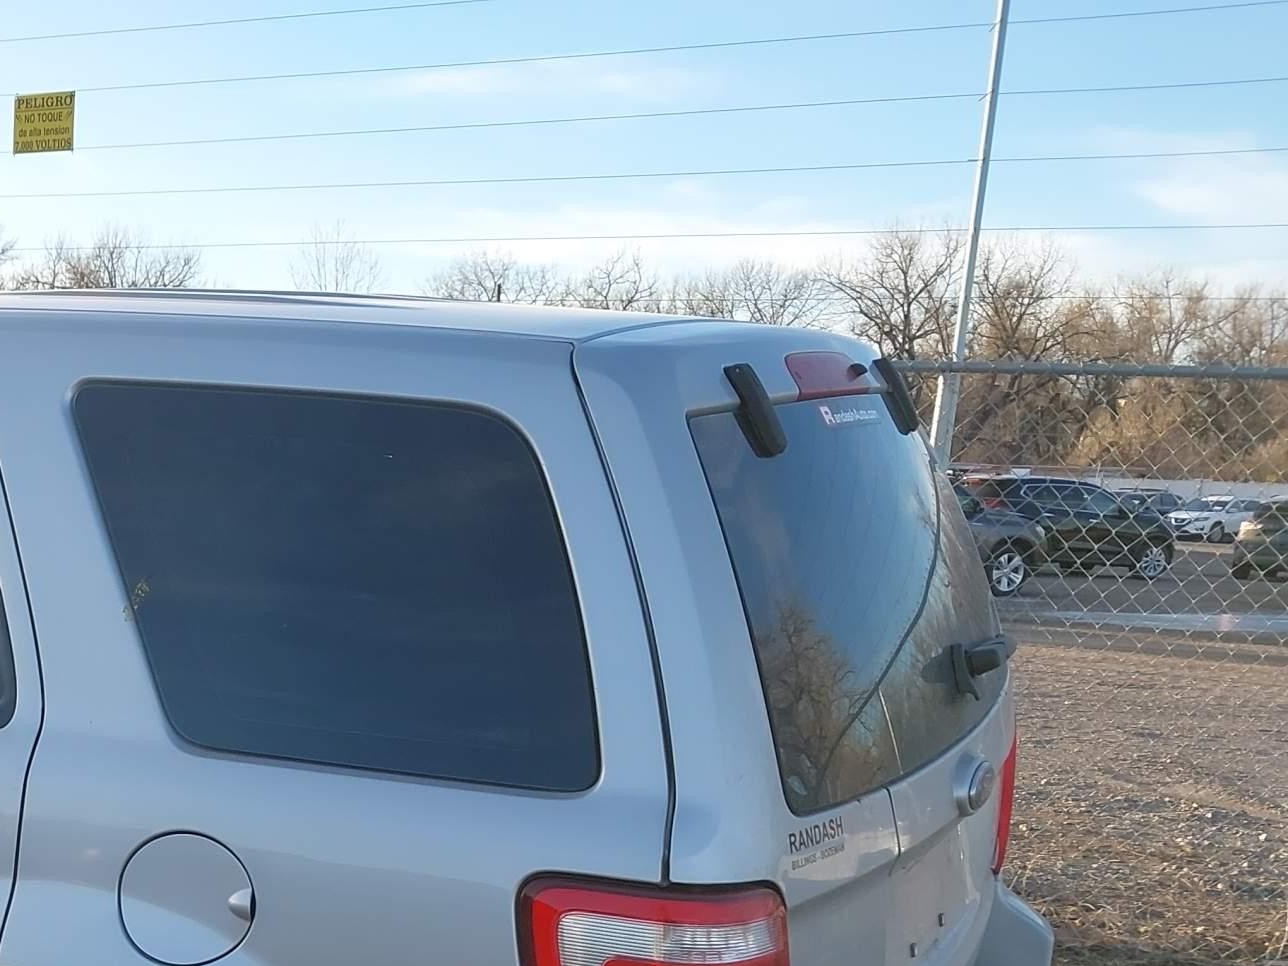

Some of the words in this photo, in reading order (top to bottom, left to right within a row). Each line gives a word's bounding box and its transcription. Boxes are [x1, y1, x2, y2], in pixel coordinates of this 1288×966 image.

[17, 96, 72, 109] PELIGRO
[25, 113, 35, 124] NO
[37, 112, 63, 122] TOQUE
[18, 128, 28, 138] de
[35, 138, 72, 151] VOLTIOS
[788, 815, 844, 854] RANDASH
